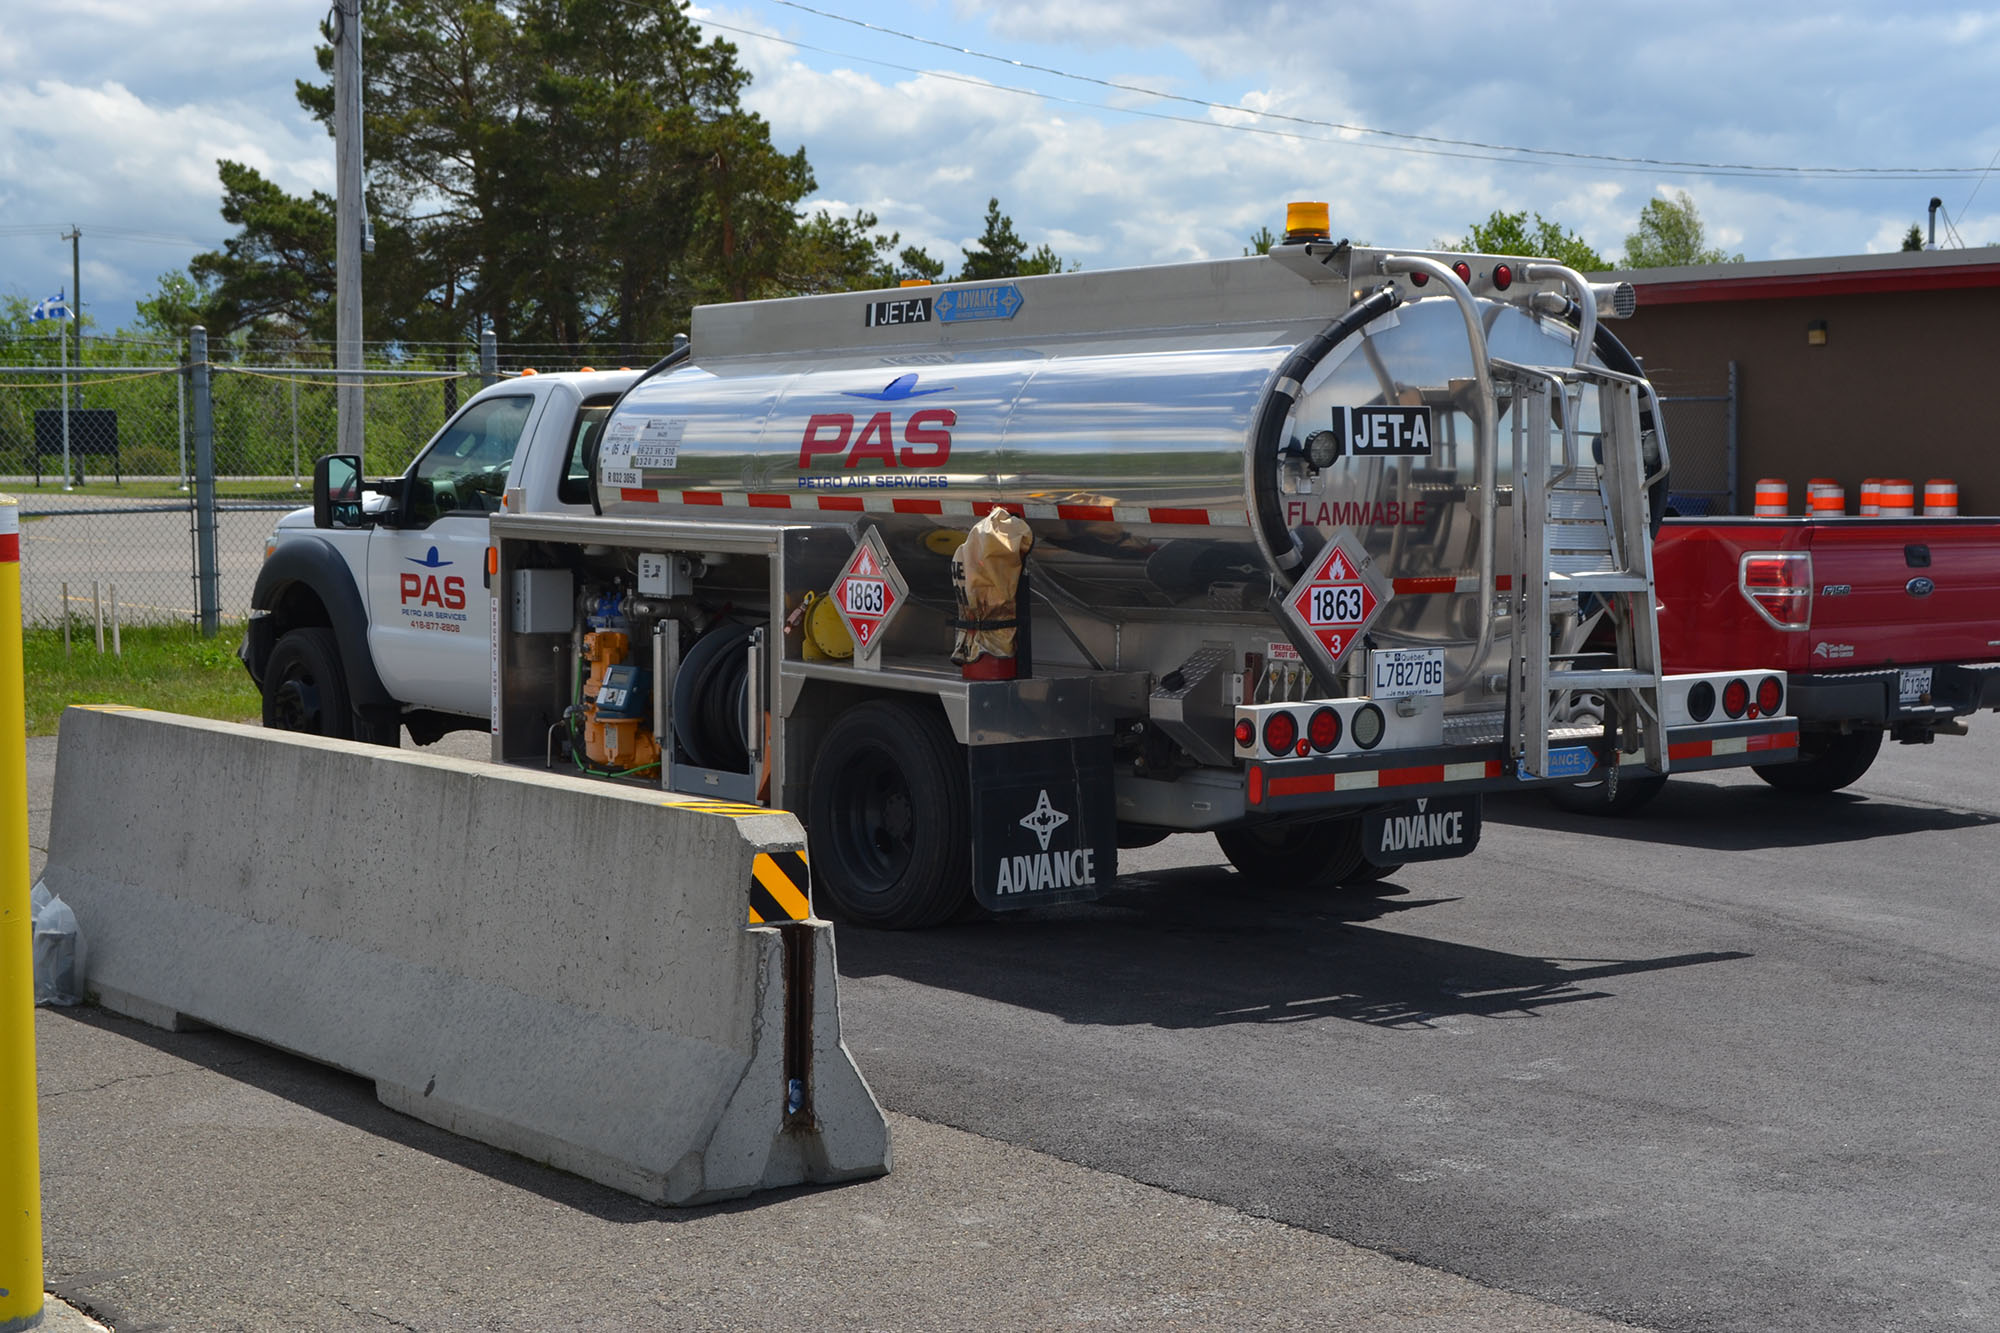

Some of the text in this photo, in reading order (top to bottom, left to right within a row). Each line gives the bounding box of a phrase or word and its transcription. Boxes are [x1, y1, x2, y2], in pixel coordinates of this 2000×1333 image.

[880, 300, 926, 325] JET-A
[956, 288, 999, 309] ADVANCE
[798, 408, 957, 469] PAS
[1354, 413, 1430, 448] JET-A
[798, 476, 949, 489] PETRO AIR SERVICES
[1287, 501, 1428, 527] FLAMMABLE
[400, 572, 467, 611] PAS
[848, 582, 884, 613] 1863
[1313, 589, 1361, 621] 1863
[860, 623, 869, 641] 3
[1330, 634, 1341, 654] 3
[1376, 660, 1442, 688] L782786
[1381, 811, 1463, 852] ADVANCE
[996, 848, 1096, 895] ADVANCE
